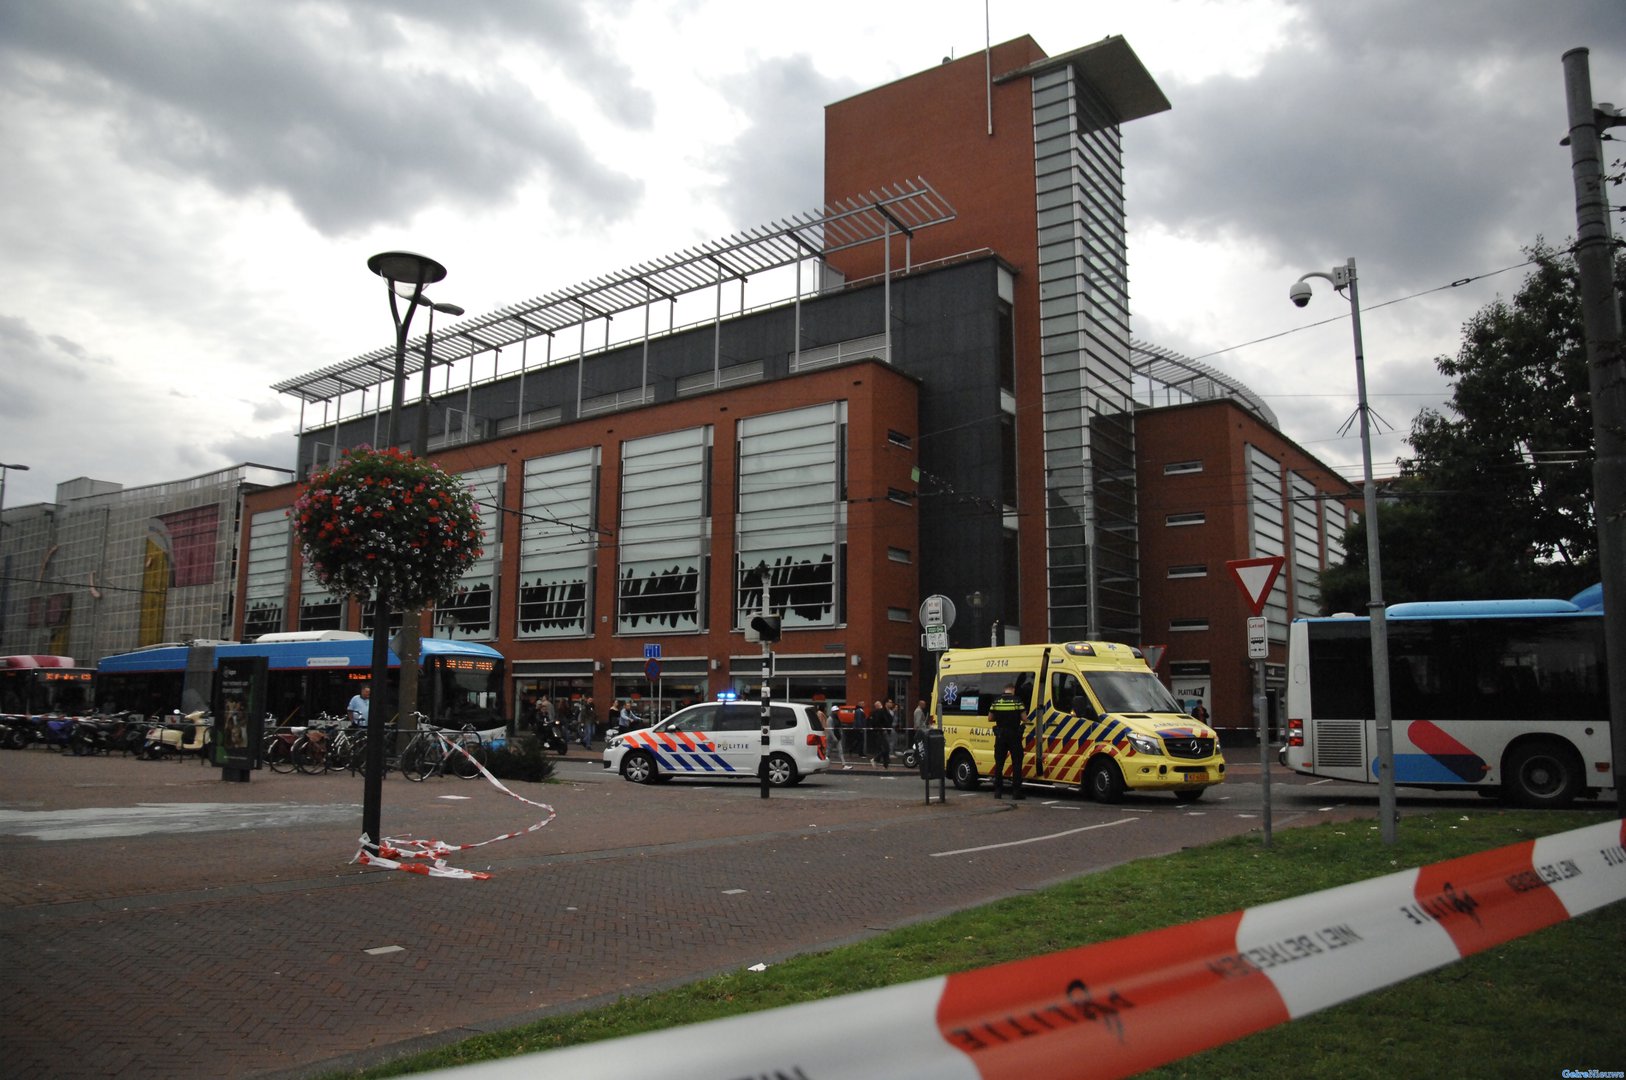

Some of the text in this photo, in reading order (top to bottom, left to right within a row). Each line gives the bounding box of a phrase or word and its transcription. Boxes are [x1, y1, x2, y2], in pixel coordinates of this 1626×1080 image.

[986, 660, 1009, 668] 07-114
[943, 726, 957, 735] 7-114
[717, 742, 749, 751] POLITIE
[1206, 923, 1364, 980] NIET BETREDEN
[952, 979, 1136, 1050] POLITIE
